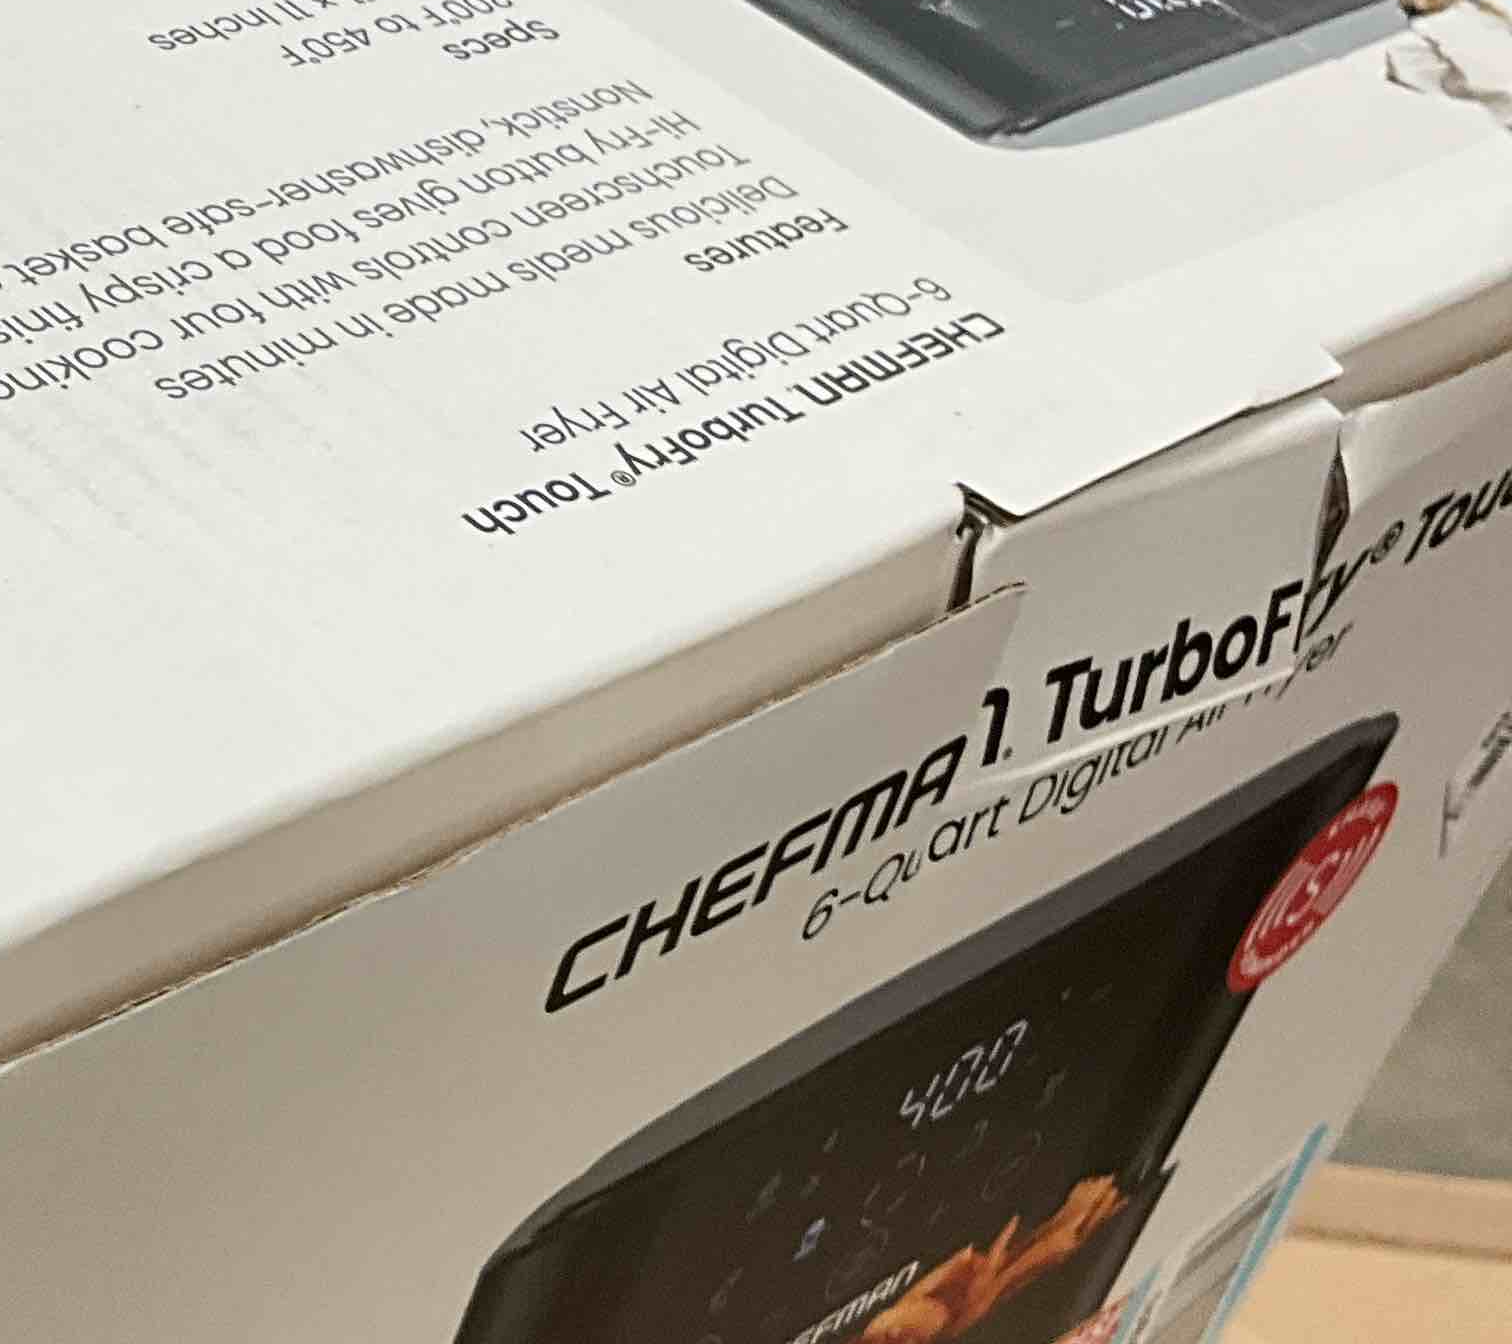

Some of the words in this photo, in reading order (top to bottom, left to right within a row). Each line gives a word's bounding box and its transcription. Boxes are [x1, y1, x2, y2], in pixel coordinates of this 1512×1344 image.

[146, 7, 281, 54] Inches
[275, 0, 311, 22] 11
[375, 12, 420, 37] to
[442, 18, 560, 63] Specs
[480, 79, 653, 139] Nonstick,
[583, 111, 701, 158] Hi-Fry
[161, 127, 486, 239] dishwasher-safe
[457, 142, 589, 198] button
[510, 144, 751, 230] Touchscreen
[351, 178, 460, 233] gives
[628, 175, 798, 241] Delicious
[2, 223, 166, 288] basket
[215, 248, 252, 272] a
[253, 217, 360, 264] food
[351, 218, 512, 289] controls
[507, 228, 632, 286] meals
[683, 208, 848, 273] Features
[77, 259, 213, 317] crispy
[259, 270, 356, 312] with
[383, 271, 510, 326] made
[794, 275, 952, 344] 6-Quart
[170, 297, 266, 342] four
[336, 311, 392, 338] in
[154, 327, 338, 402] minutes
[675, 328, 810, 396] Digital
[796, 310, 1005, 407] CHEFMAN
[619, 377, 681, 415] Air
[517, 400, 629, 457] Fryer
[460, 469, 613, 537] Touch
[900, 1018, 1029, 1129] 400
